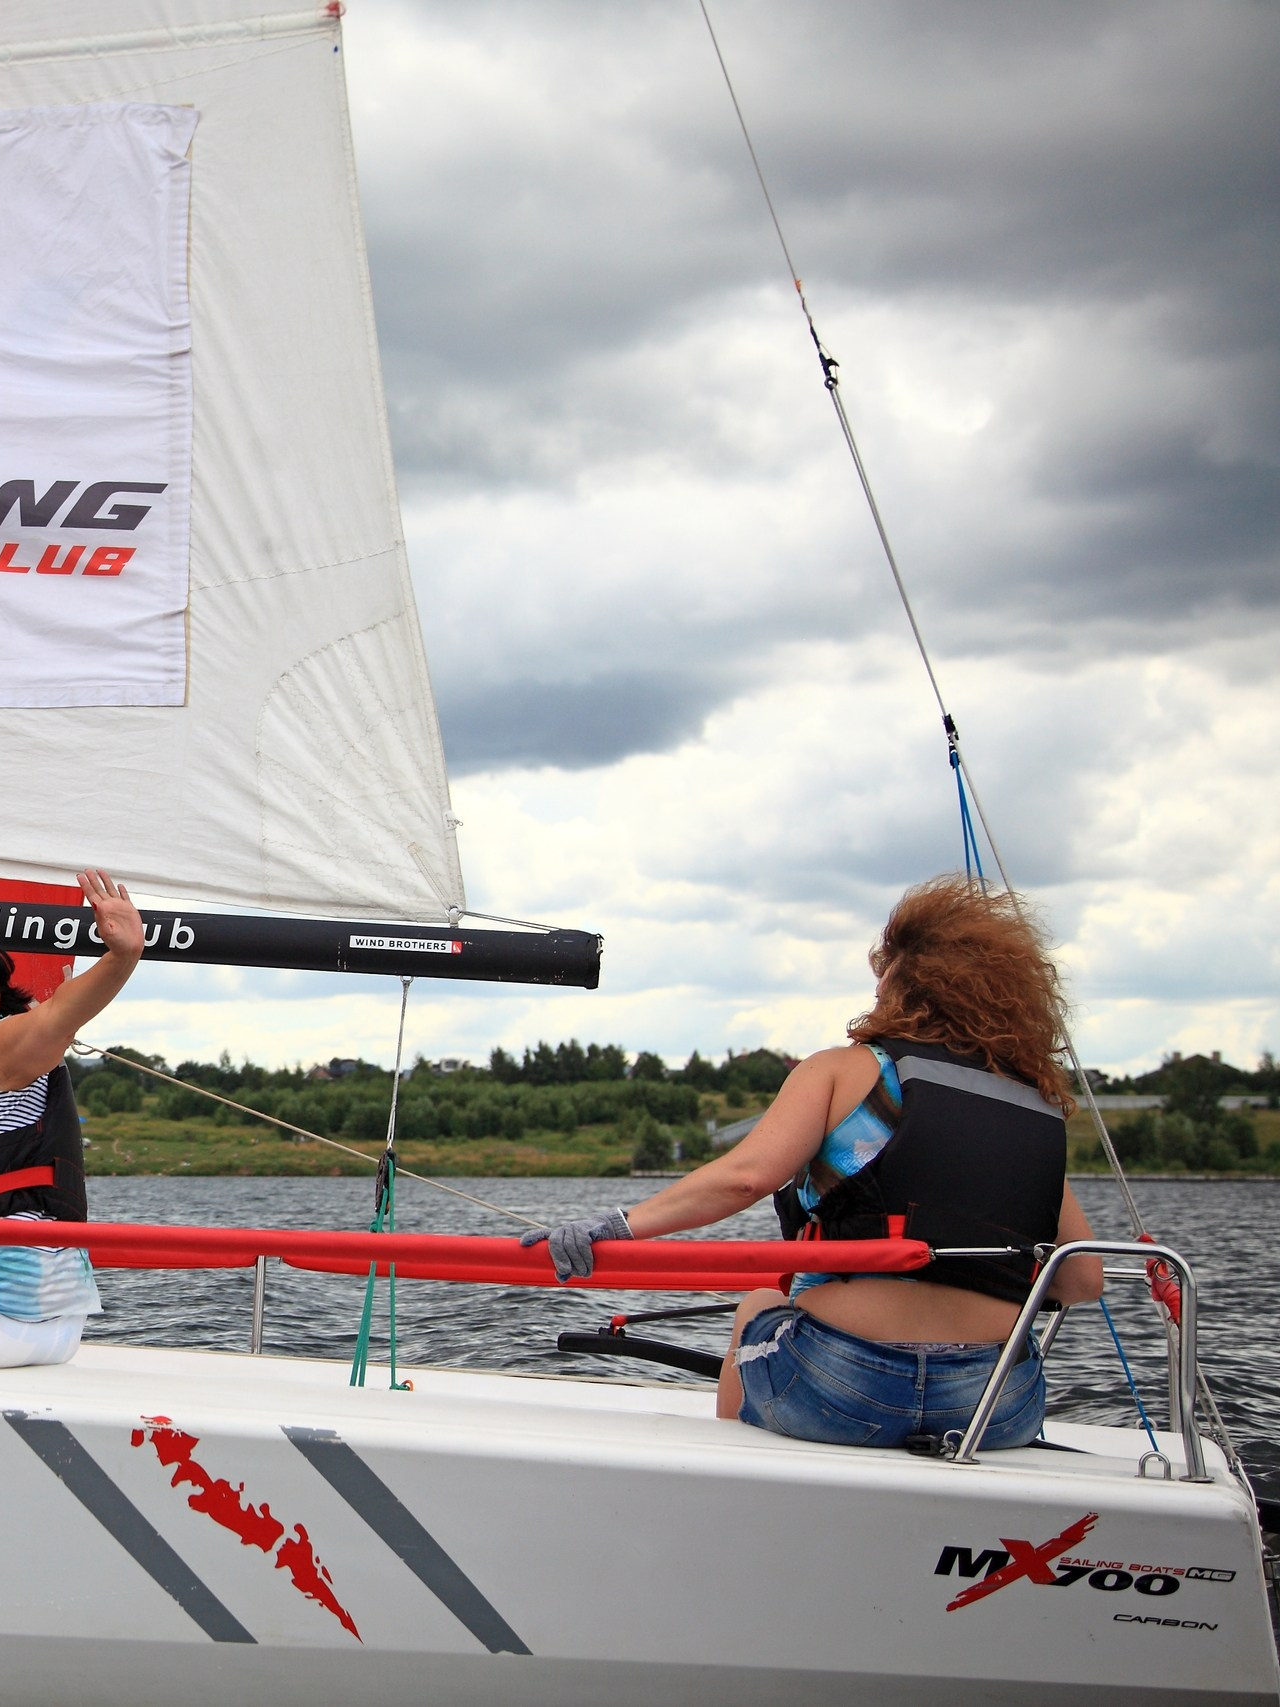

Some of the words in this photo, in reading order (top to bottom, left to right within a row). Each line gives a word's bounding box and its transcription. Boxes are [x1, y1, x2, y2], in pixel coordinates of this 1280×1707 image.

[355, 938, 385, 948] WIND
[388, 940, 447, 951] BROTHERS
[1059, 1556, 1123, 1569] SAILING
[1128, 1563, 1186, 1576] BOATS
[1113, 1613, 1219, 1631] CARBON
